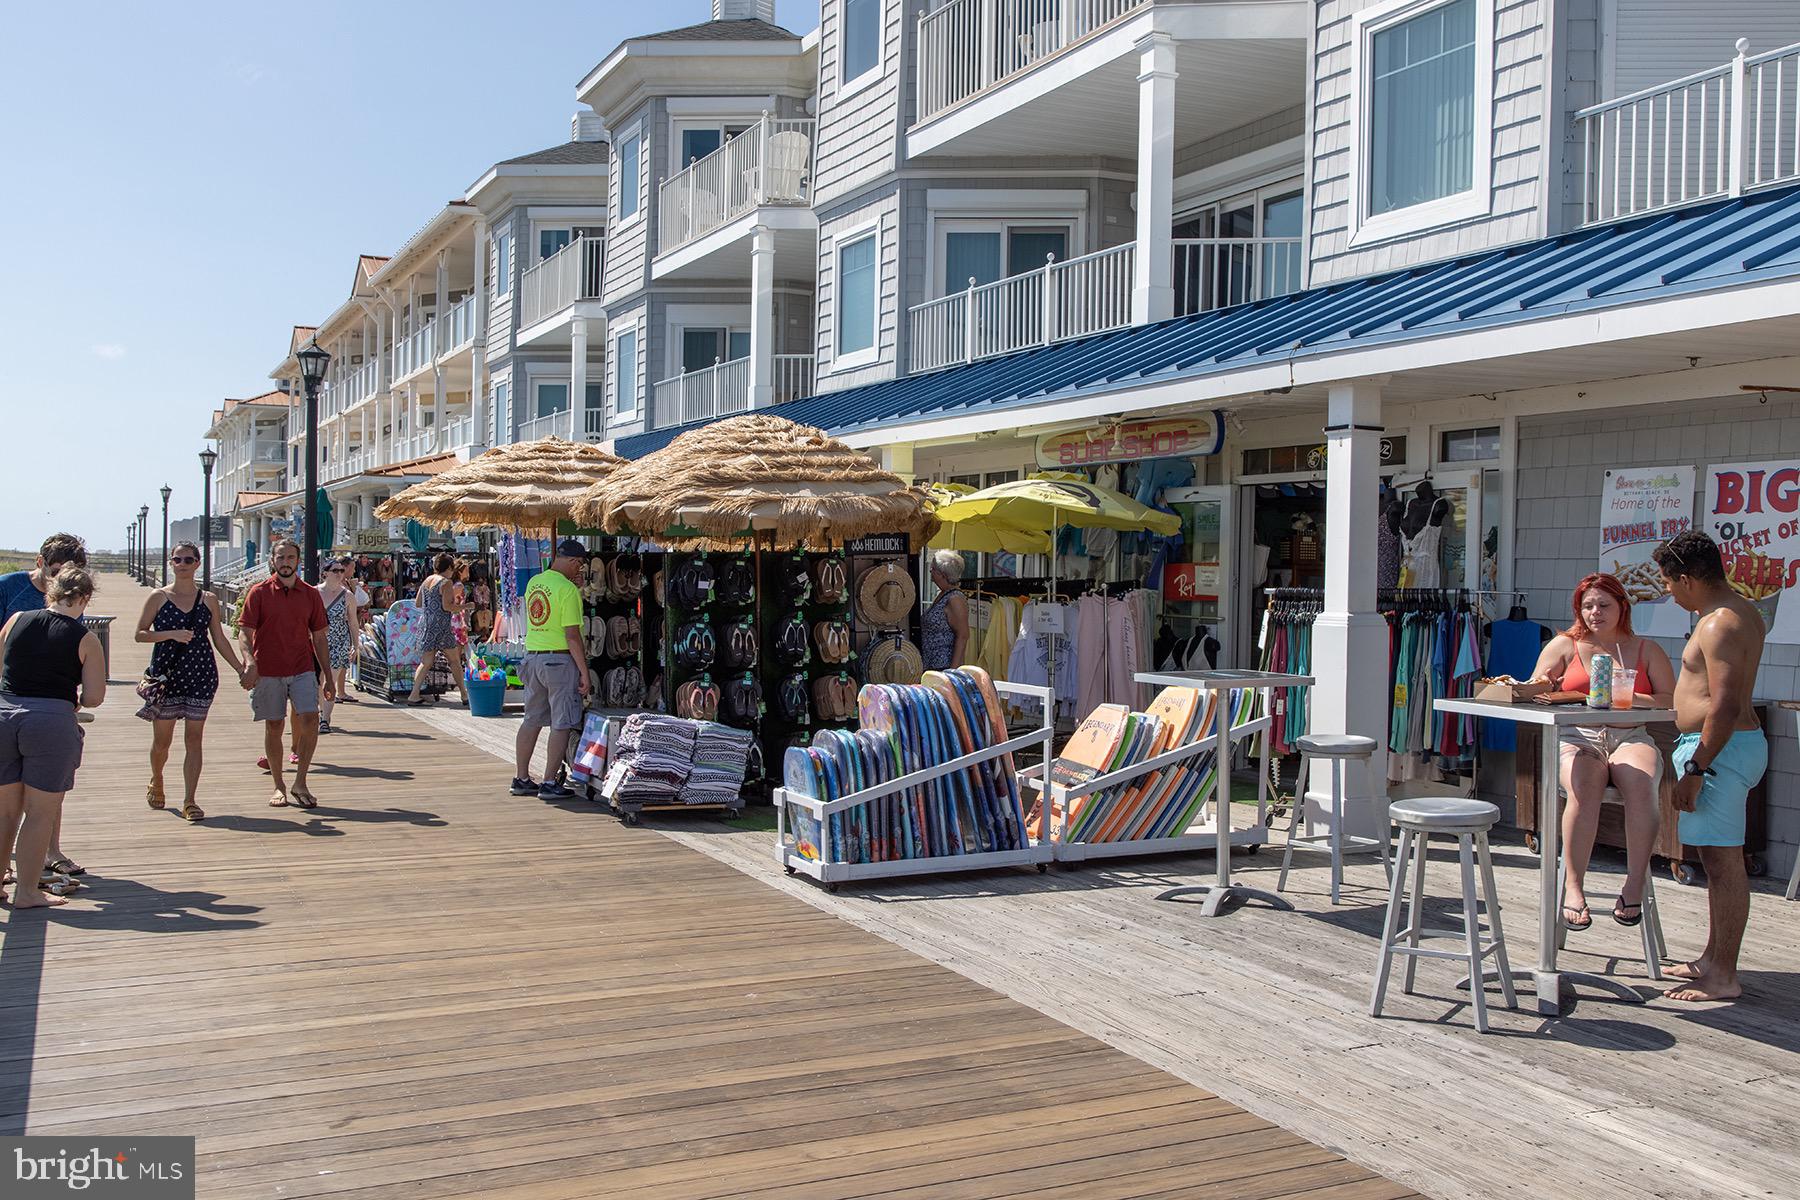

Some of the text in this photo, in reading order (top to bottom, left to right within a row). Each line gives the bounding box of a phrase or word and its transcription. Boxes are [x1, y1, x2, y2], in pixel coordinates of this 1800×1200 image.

[1060, 430, 1189, 465] SURF SHOP
[1611, 495, 1681, 511] Home of the
[1712, 467, 1800, 514] BIG
[357, 534, 389, 546] Flojos
[1602, 515, 1690, 544] FUNNEL FRY
[1718, 519, 1799, 554] UCKET OF
[864, 538, 900, 551] HEMLOCK
